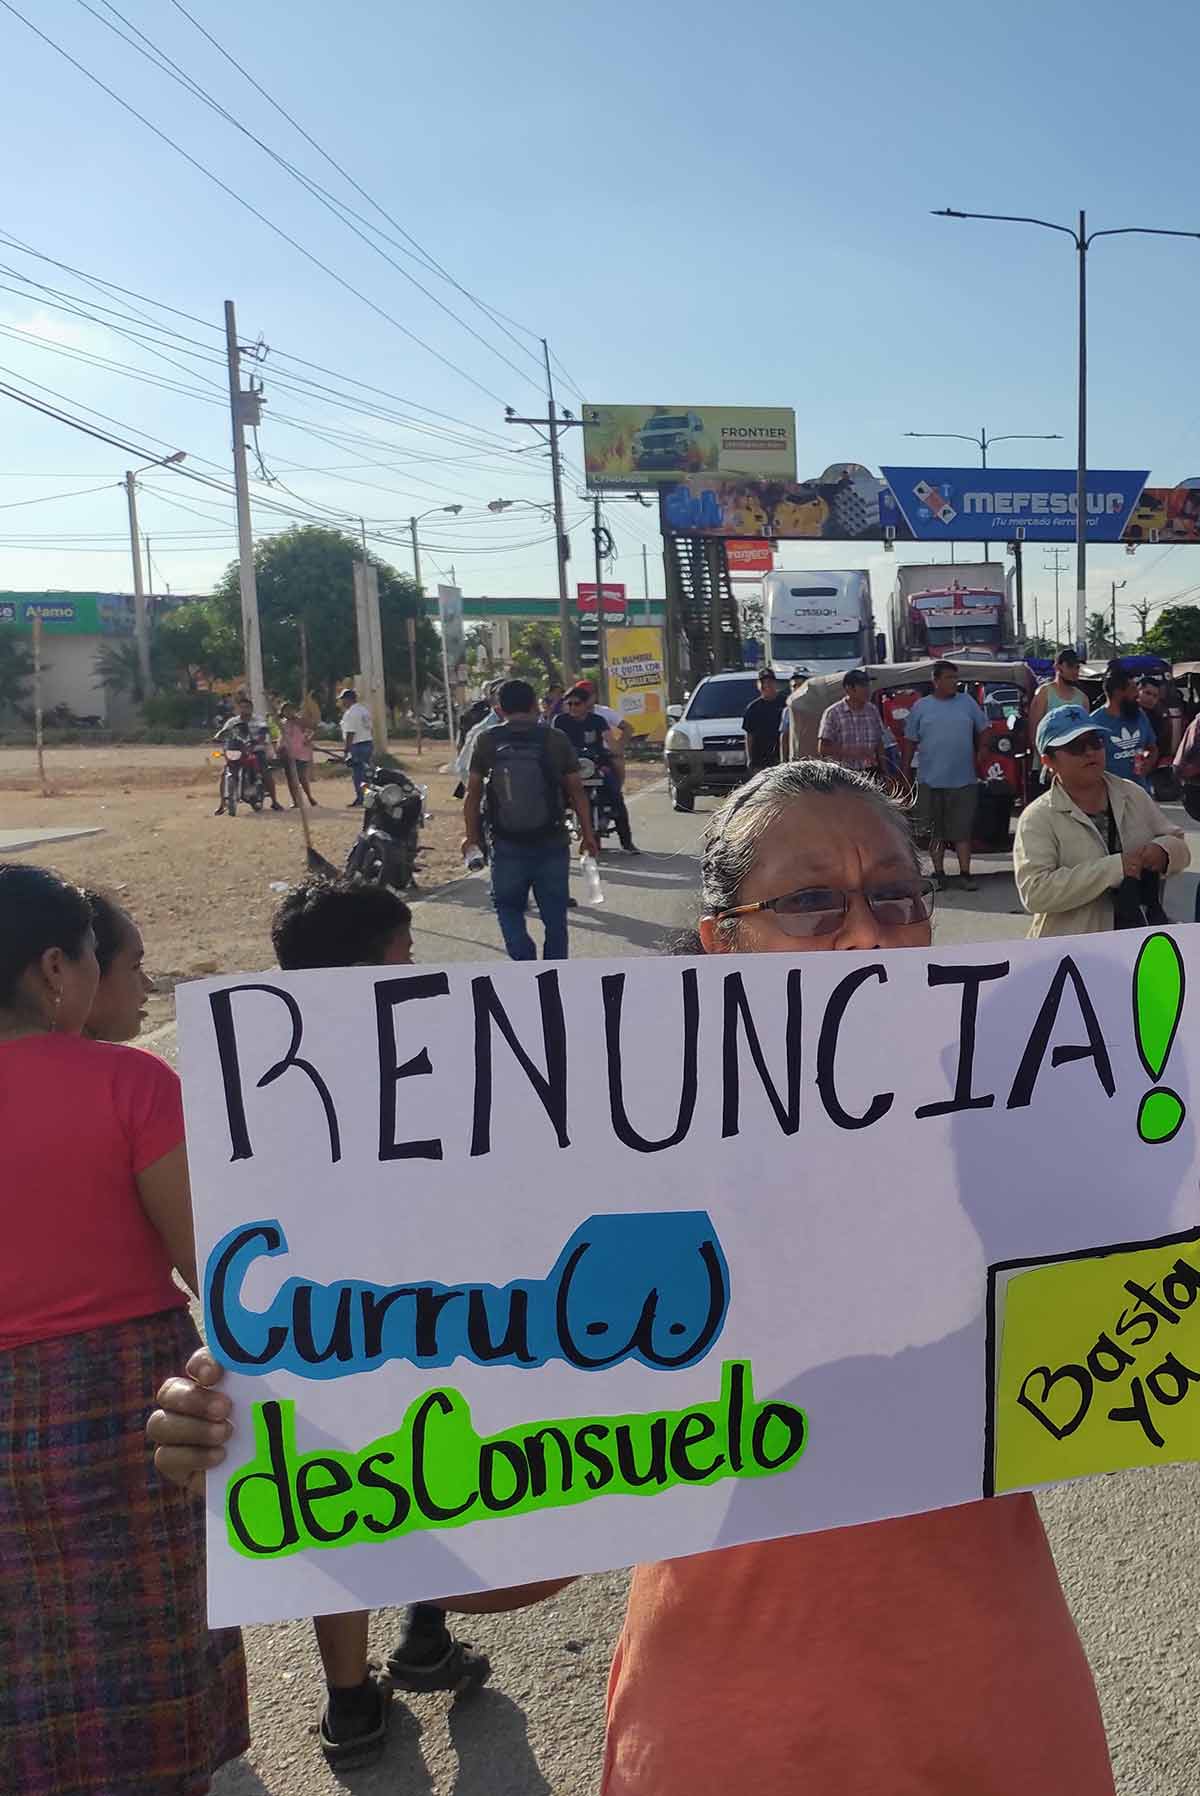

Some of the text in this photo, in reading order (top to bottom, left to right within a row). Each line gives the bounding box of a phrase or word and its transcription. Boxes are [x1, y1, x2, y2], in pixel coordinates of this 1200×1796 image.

[721, 428, 787, 438] FRONTIER
[208, 931, 1186, 1163] RENUNCIA!
[229, 1363, 803, 1554] desConsuelo
